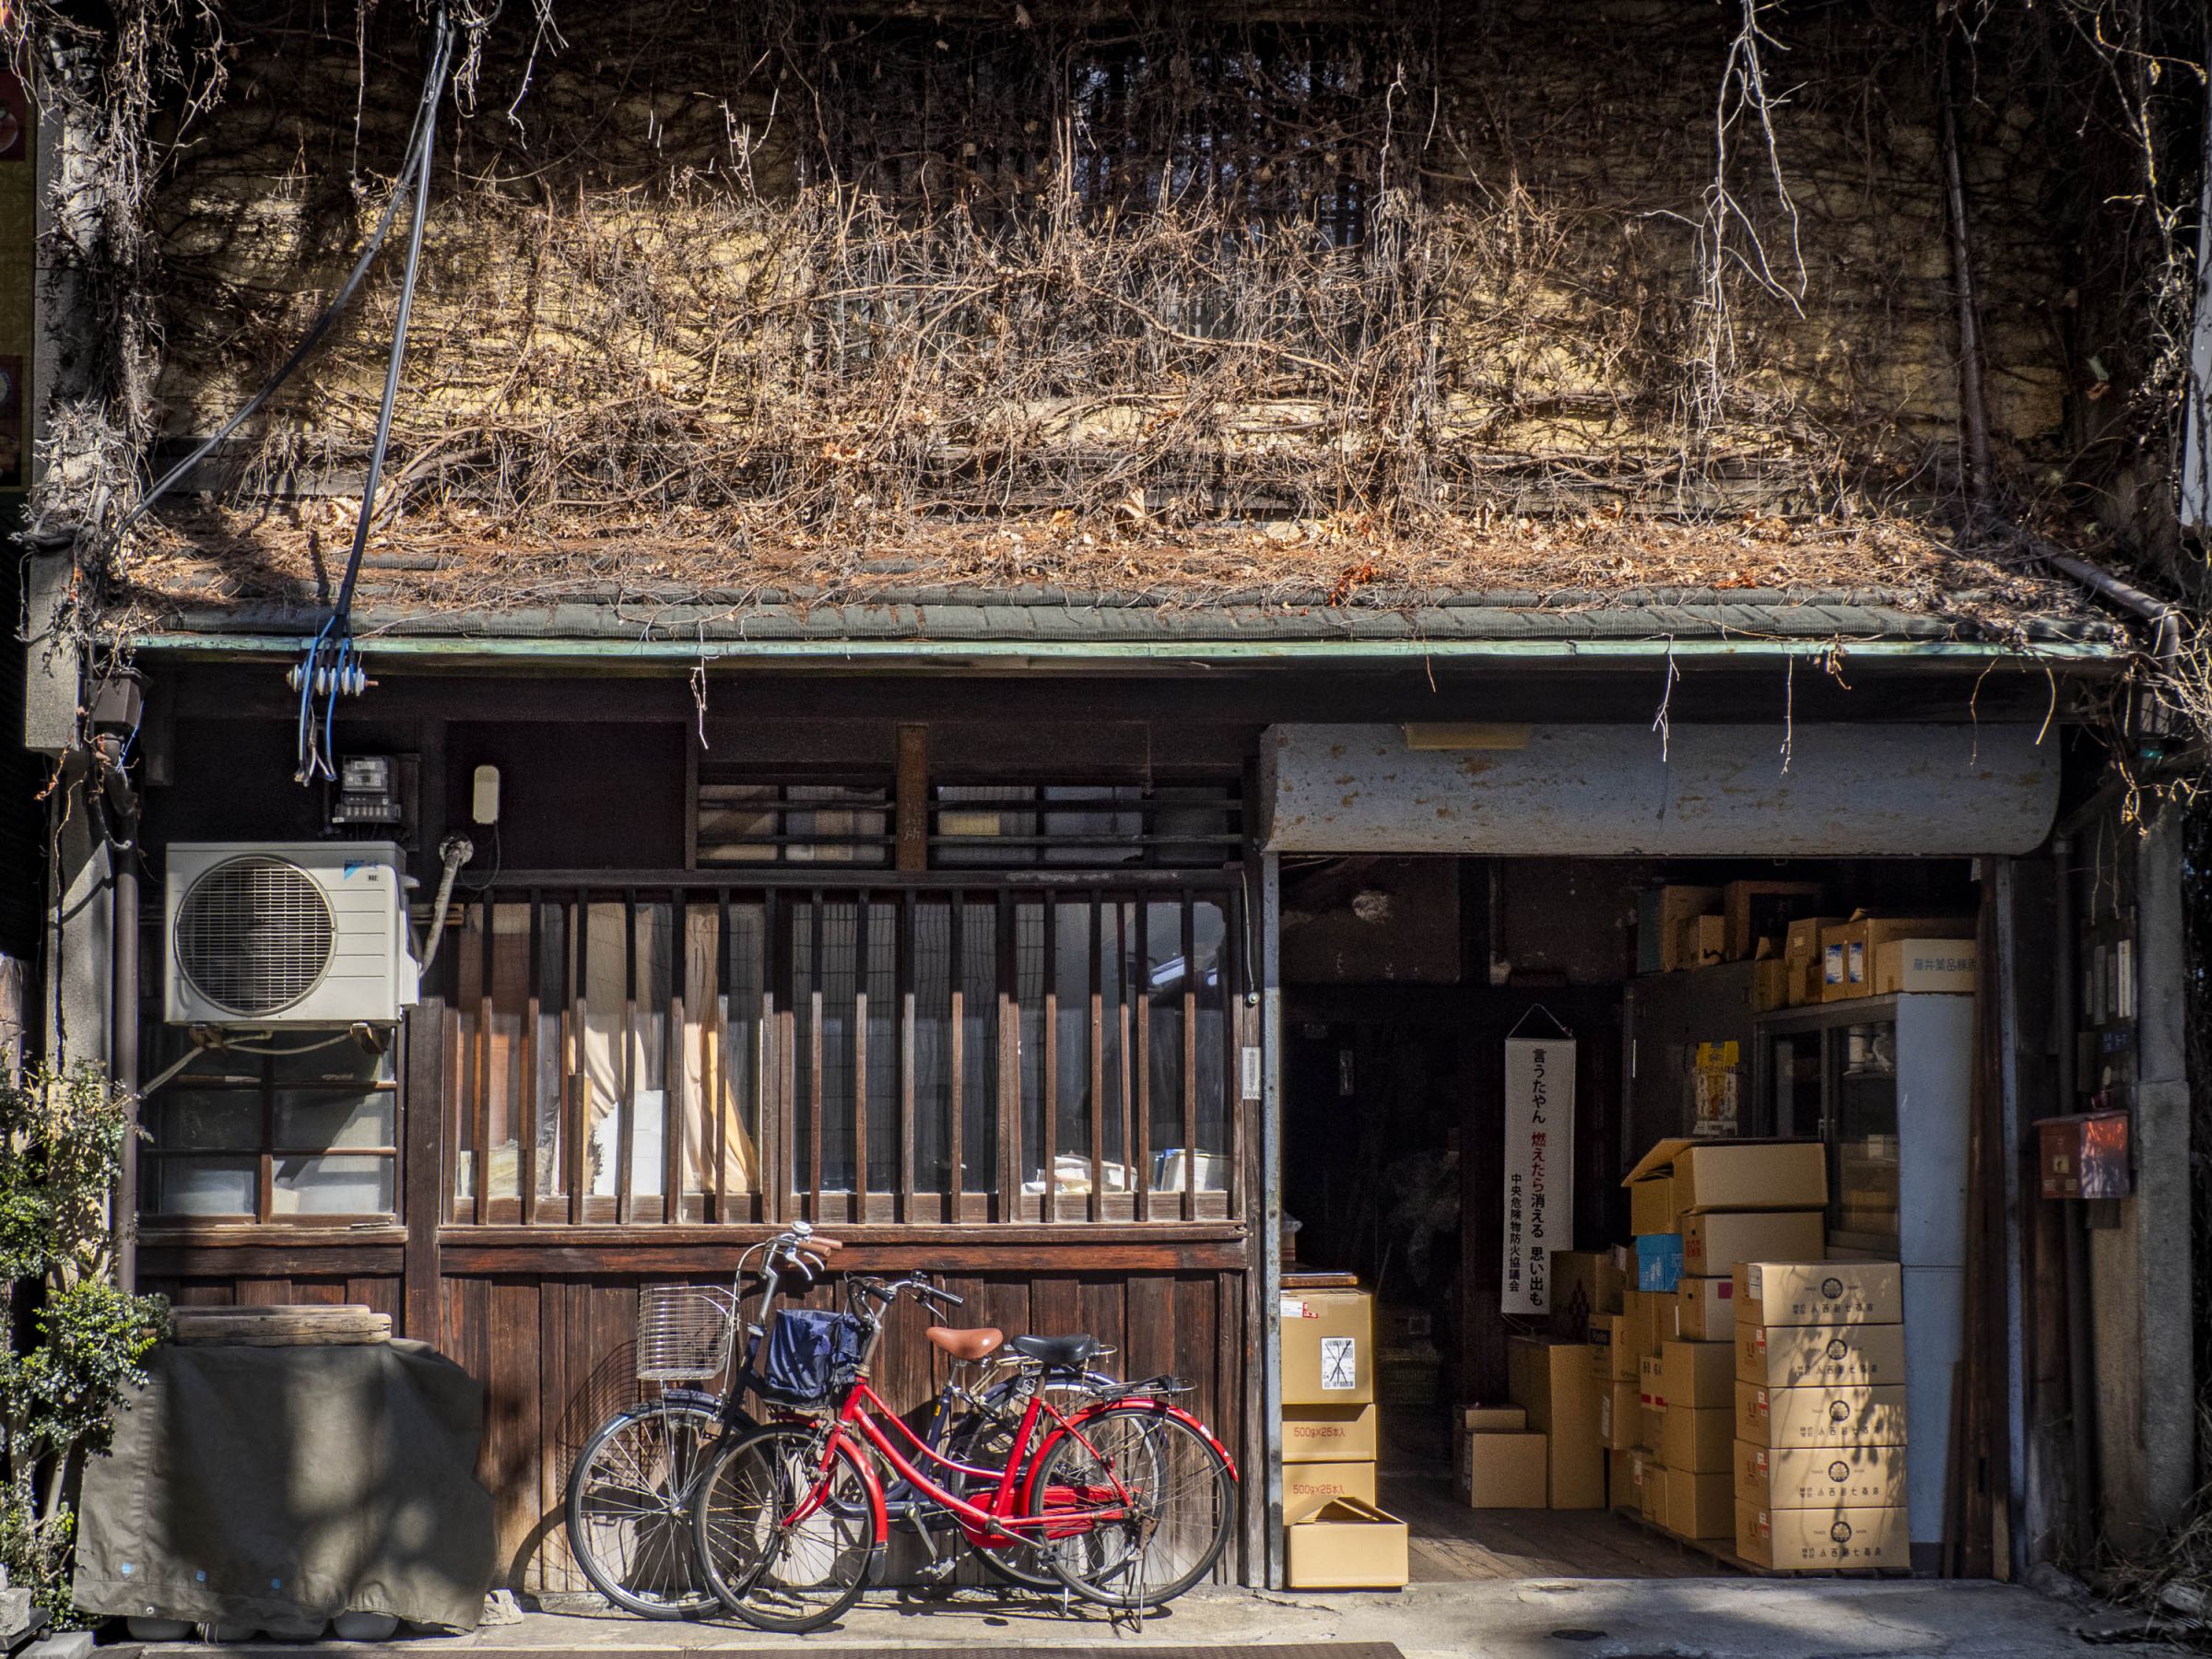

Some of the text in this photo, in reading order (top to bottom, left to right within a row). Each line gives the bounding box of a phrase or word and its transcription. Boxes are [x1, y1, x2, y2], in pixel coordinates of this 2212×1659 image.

[1529, 1048, 1547, 1307] 言うたやん 燃えたら消える 思い出も
